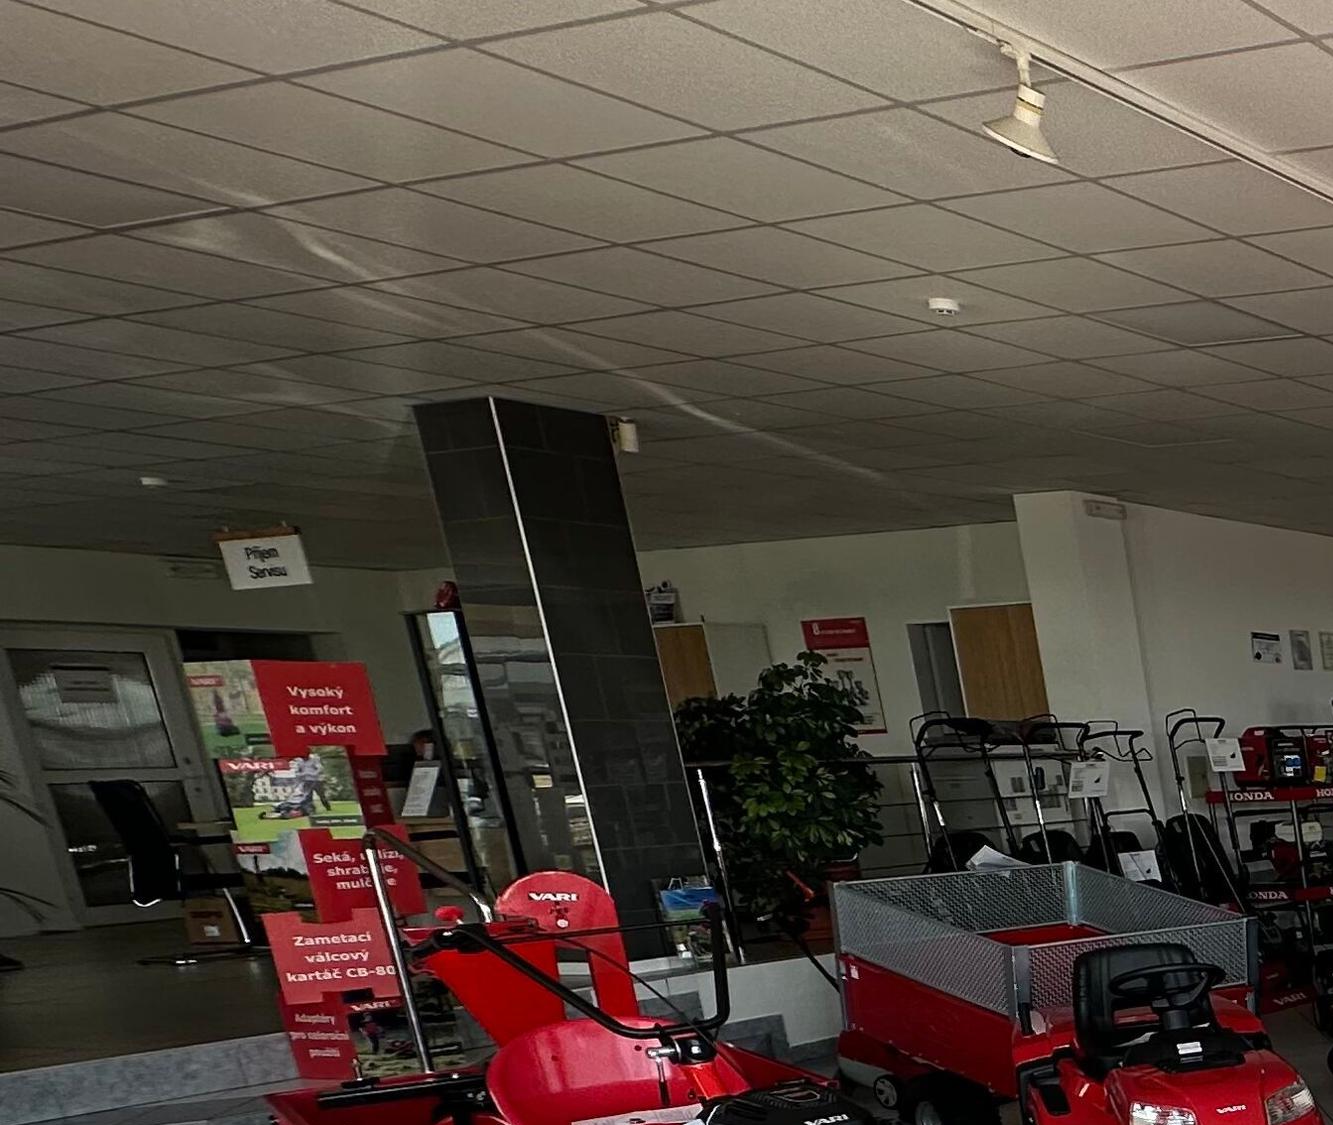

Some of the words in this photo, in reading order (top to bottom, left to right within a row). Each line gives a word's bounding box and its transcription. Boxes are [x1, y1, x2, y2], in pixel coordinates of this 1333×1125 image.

[244, 546, 279, 563] Příjem
[249, 565, 287, 579] Servisu
[286, 685, 344, 700] Vysoký
[289, 704, 353, 716] komfort
[296, 724, 305, 733] a
[310, 723, 356, 736] výkon
[313, 851, 356, 863] Seká,
[528, 891, 578, 903] VARI
[292, 930, 372, 946] Zametací
[304, 949, 370, 965] válcový
[286, 966, 343, 983] kartáč
[346, 964, 397, 979] CB-80
[1273, 992, 1307, 1005] VARI
[350, 1000, 392, 1012] VARI
[1216, 1104, 1247, 1115] VARI
